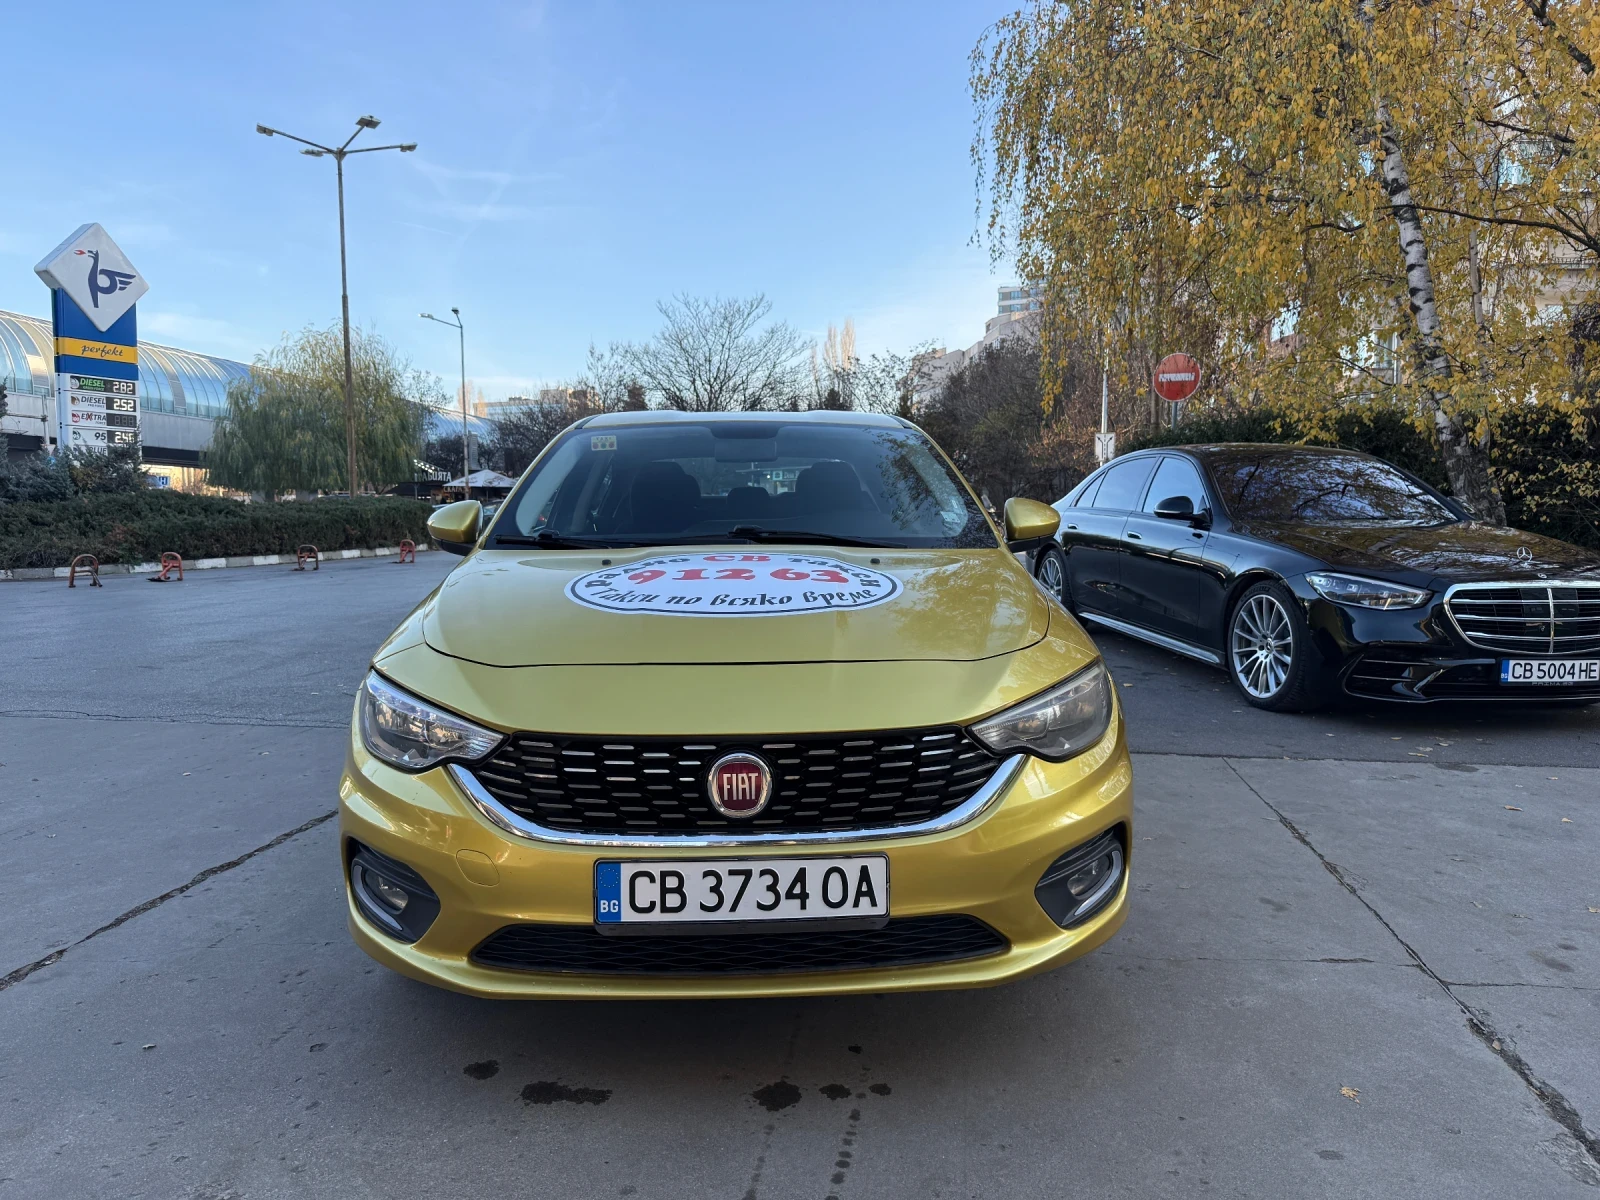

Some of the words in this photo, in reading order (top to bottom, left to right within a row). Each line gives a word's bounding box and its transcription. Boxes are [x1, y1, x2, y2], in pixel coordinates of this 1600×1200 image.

[81, 345, 123, 357] perfekt
[80, 378, 105, 388] DIESEL
[81, 396, 106, 405] DIESEL
[94, 432, 106, 440] 95
[584, 558, 690, 588] Радио
[788, 557, 881, 588] такси
[590, 588, 661, 603] Такси
[665, 595, 703, 605] по
[709, 593, 793, 606] всяко
[802, 589, 877, 606] време
[1511, 662, 1534, 679] CB
[1536, 662, 1575, 680] 5004
[1579, 662, 1598, 679] HE
[722, 772, 759, 801] FIAT
[629, 870, 688, 914] CB
[699, 866, 810, 913] 3734
[821, 865, 878, 909] OA
[600, 900, 619, 913] BG
